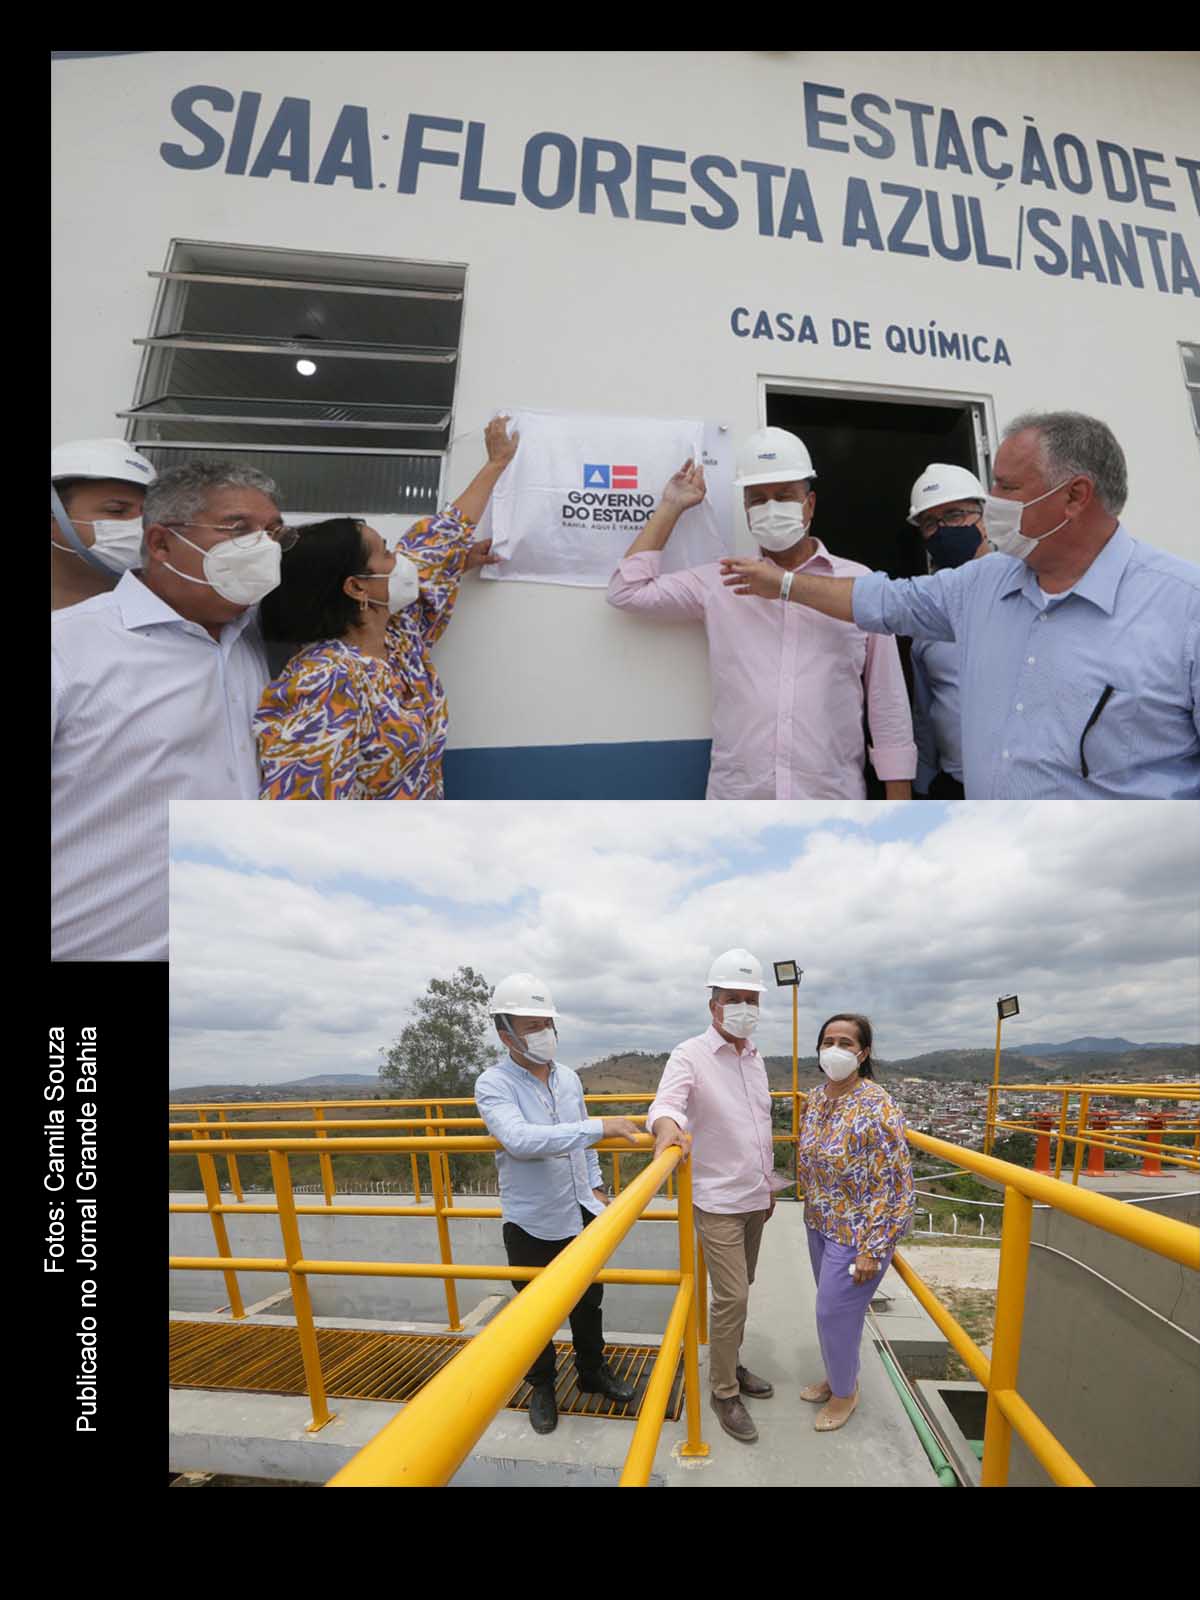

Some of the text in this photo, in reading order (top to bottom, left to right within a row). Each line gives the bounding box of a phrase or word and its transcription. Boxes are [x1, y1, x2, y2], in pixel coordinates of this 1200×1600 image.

[397, 113, 824, 243] FLORESTA
[1096, 139, 1177, 212] DE
[730, 307, 1012, 366] CASA DE QUÍMICA
[563, 505, 590, 520] DO
[568, 491, 654, 507] GOVERNO
